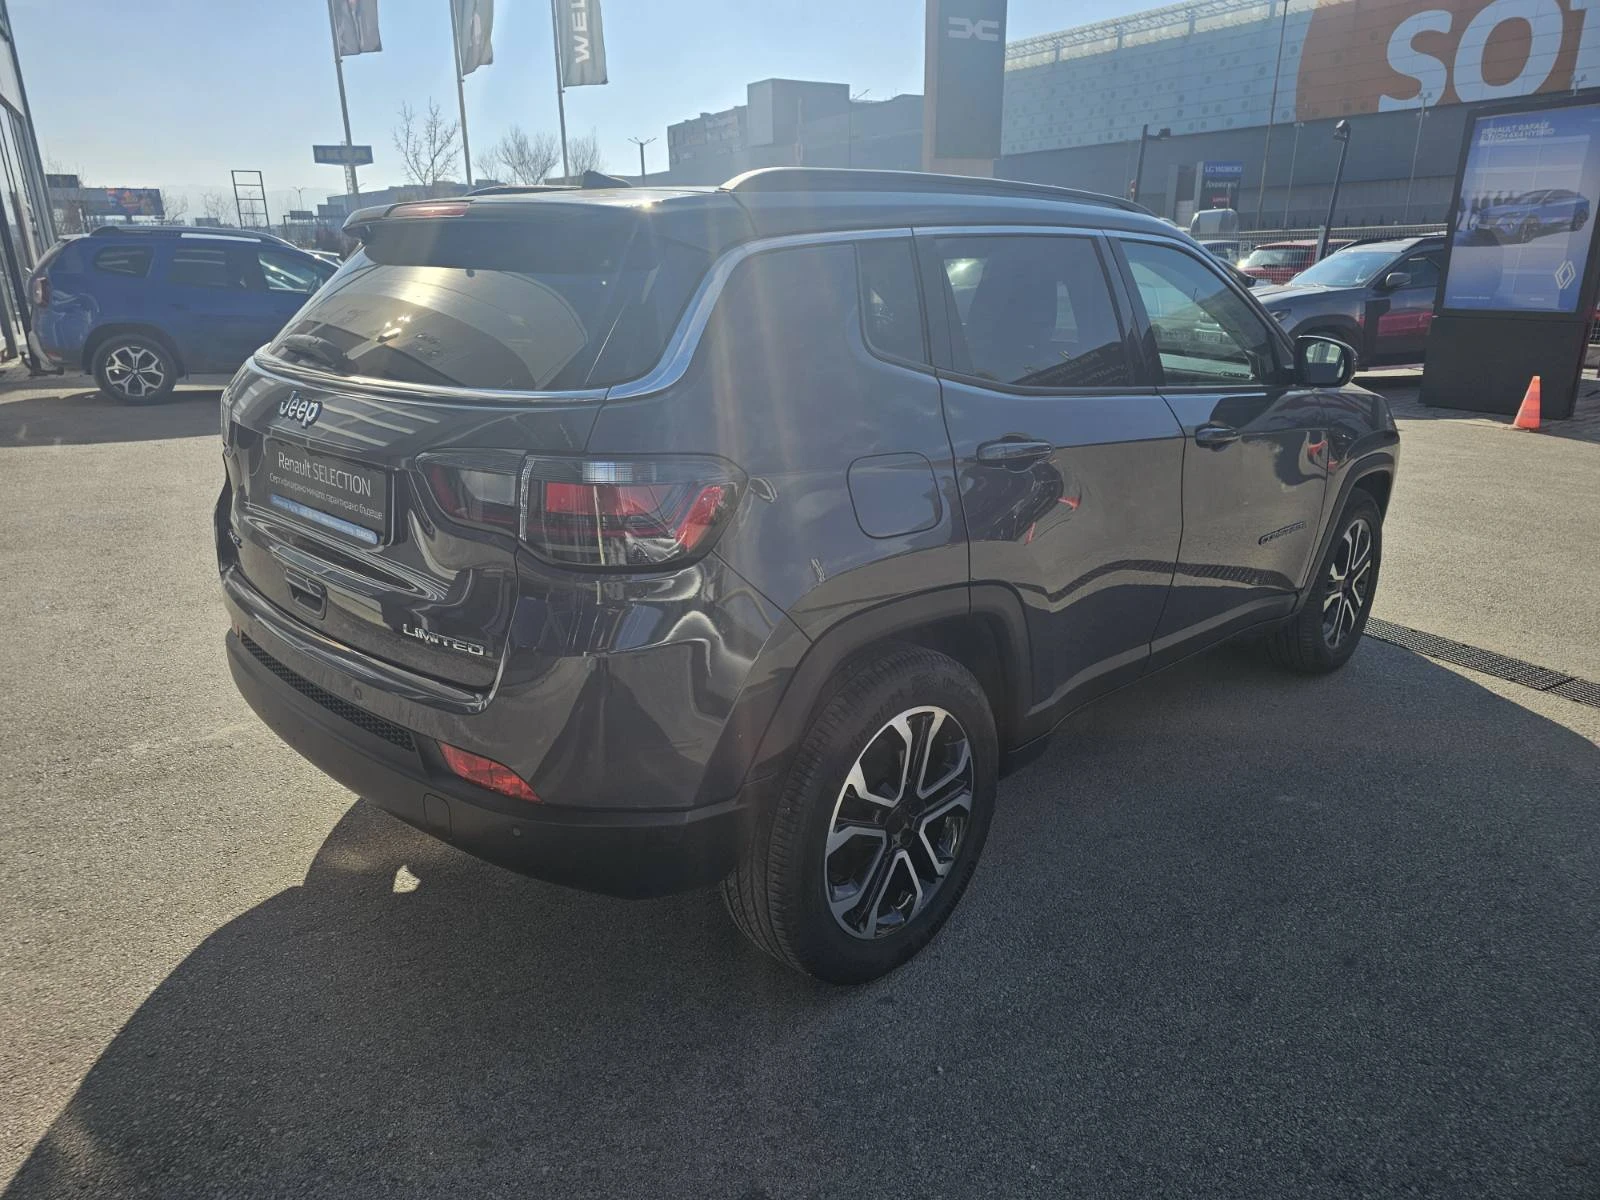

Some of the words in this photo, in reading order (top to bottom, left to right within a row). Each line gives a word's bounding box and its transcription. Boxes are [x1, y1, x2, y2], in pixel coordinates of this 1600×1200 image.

[279, 390, 319, 427] Jeep
[278, 451, 311, 478] Renault
[312, 462, 371, 497] SELECTION
[402, 623, 484, 656] LIMITED
